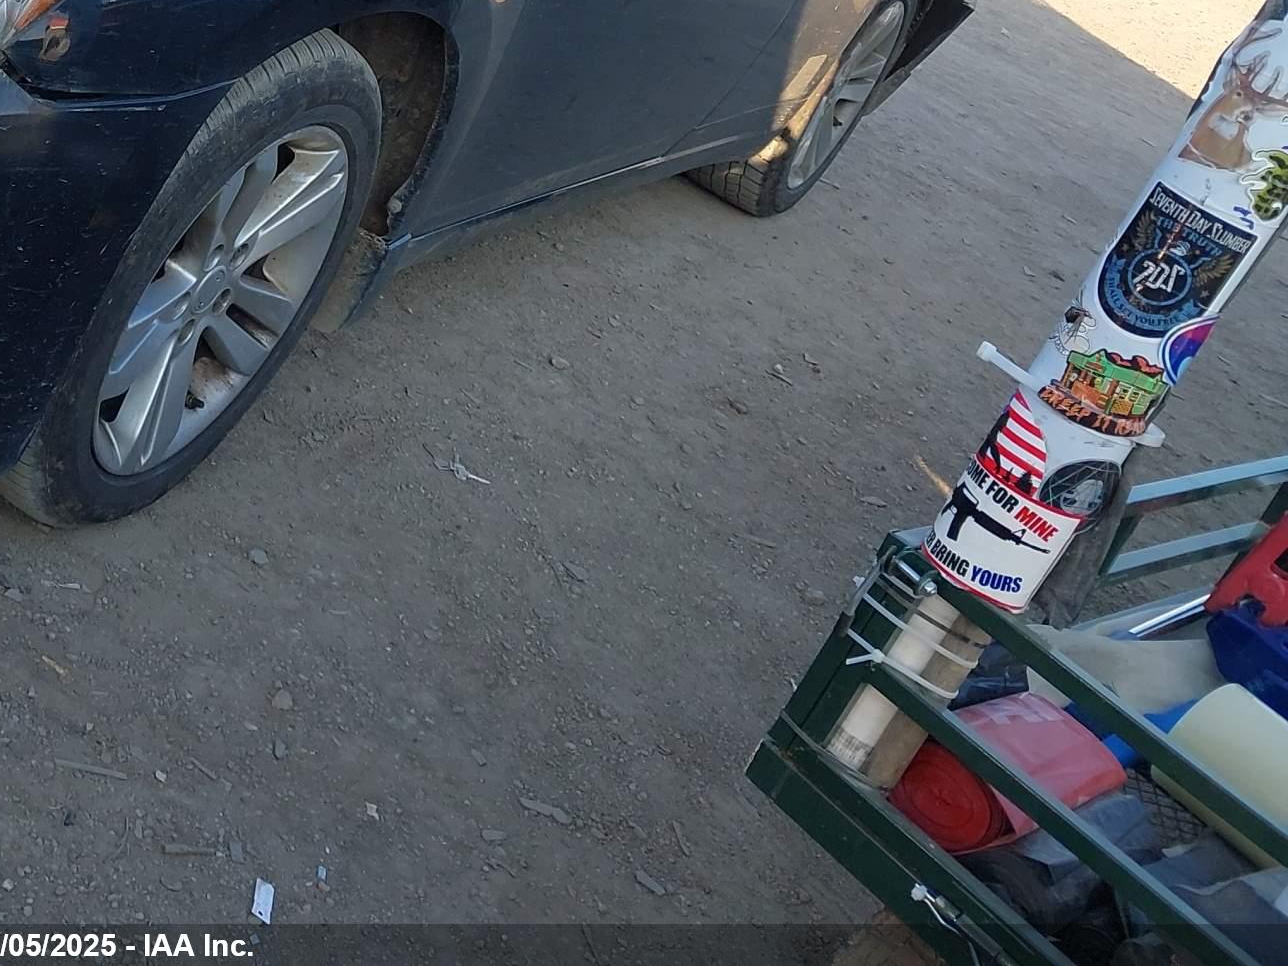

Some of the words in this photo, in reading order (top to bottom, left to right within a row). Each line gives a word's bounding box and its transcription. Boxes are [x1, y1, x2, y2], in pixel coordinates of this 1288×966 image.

[984, 483, 1020, 514] FOR
[1014, 505, 1060, 543] MINE
[930, 538, 970, 577] BRING
[970, 564, 1024, 594] YOURS
